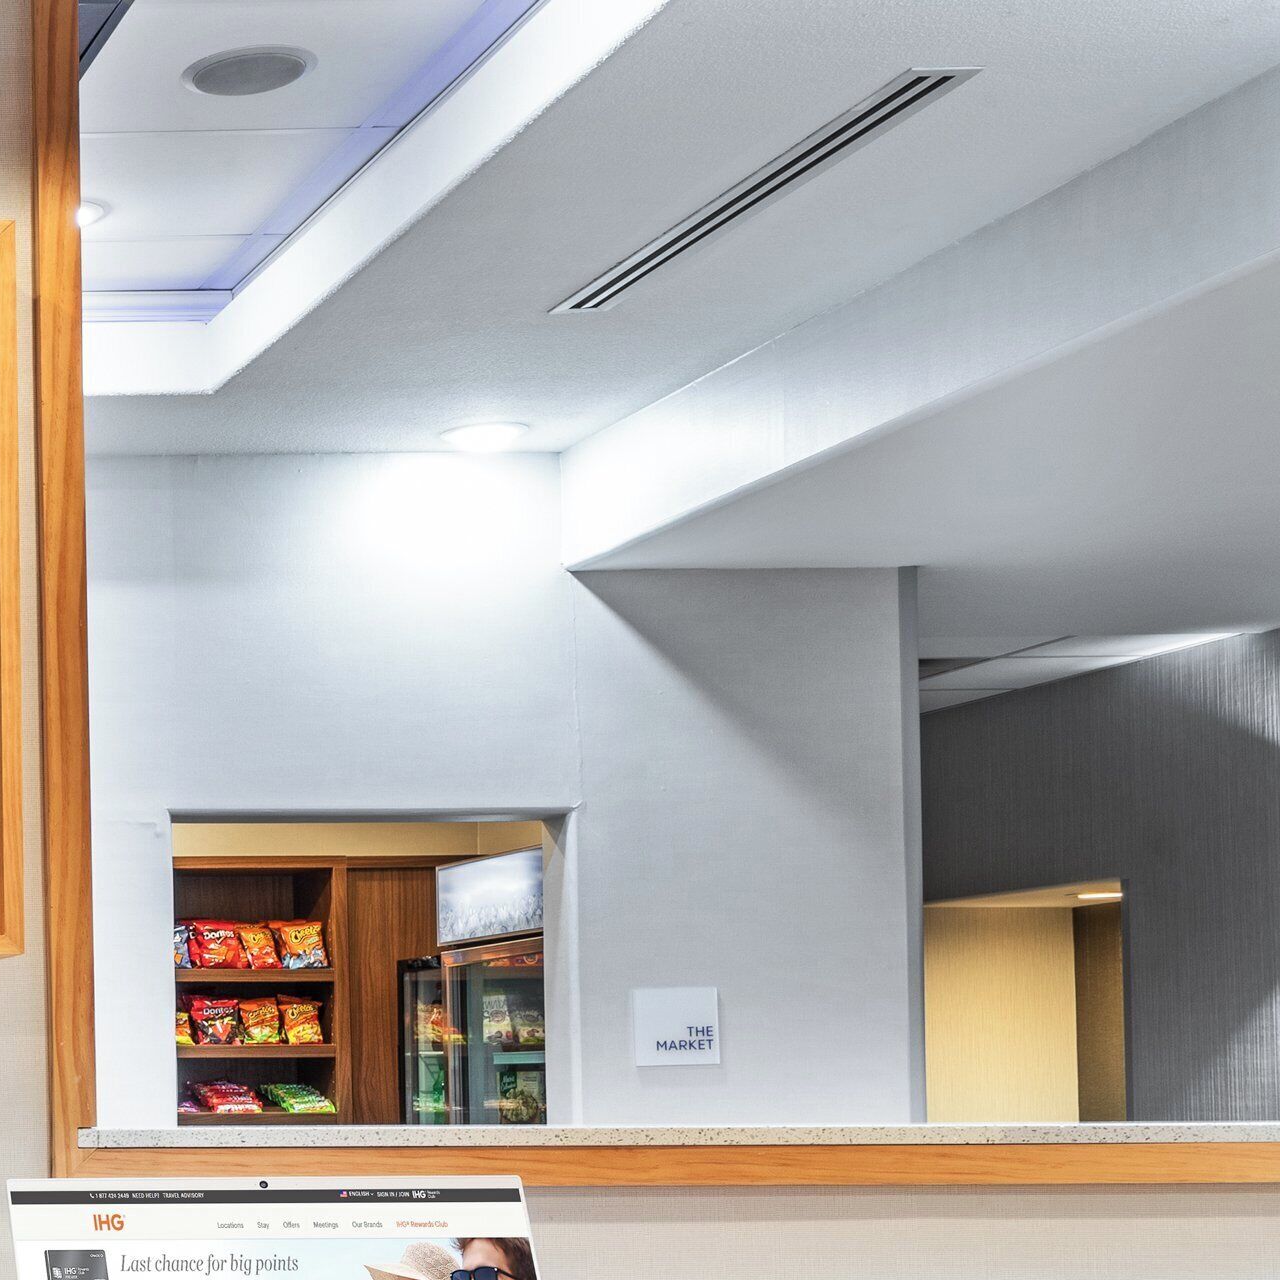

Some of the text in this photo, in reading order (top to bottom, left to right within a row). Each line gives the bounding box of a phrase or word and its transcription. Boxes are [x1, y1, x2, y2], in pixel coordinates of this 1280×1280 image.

[203, 930, 235, 941] Doritos
[203, 1006, 234, 1016] Doritos
[687, 1026, 714, 1037] THE
[656, 1039, 714, 1051] MARKET
[313, 1221, 339, 1229] Meetings
[120, 1253, 299, 1276] Last chance for big points
